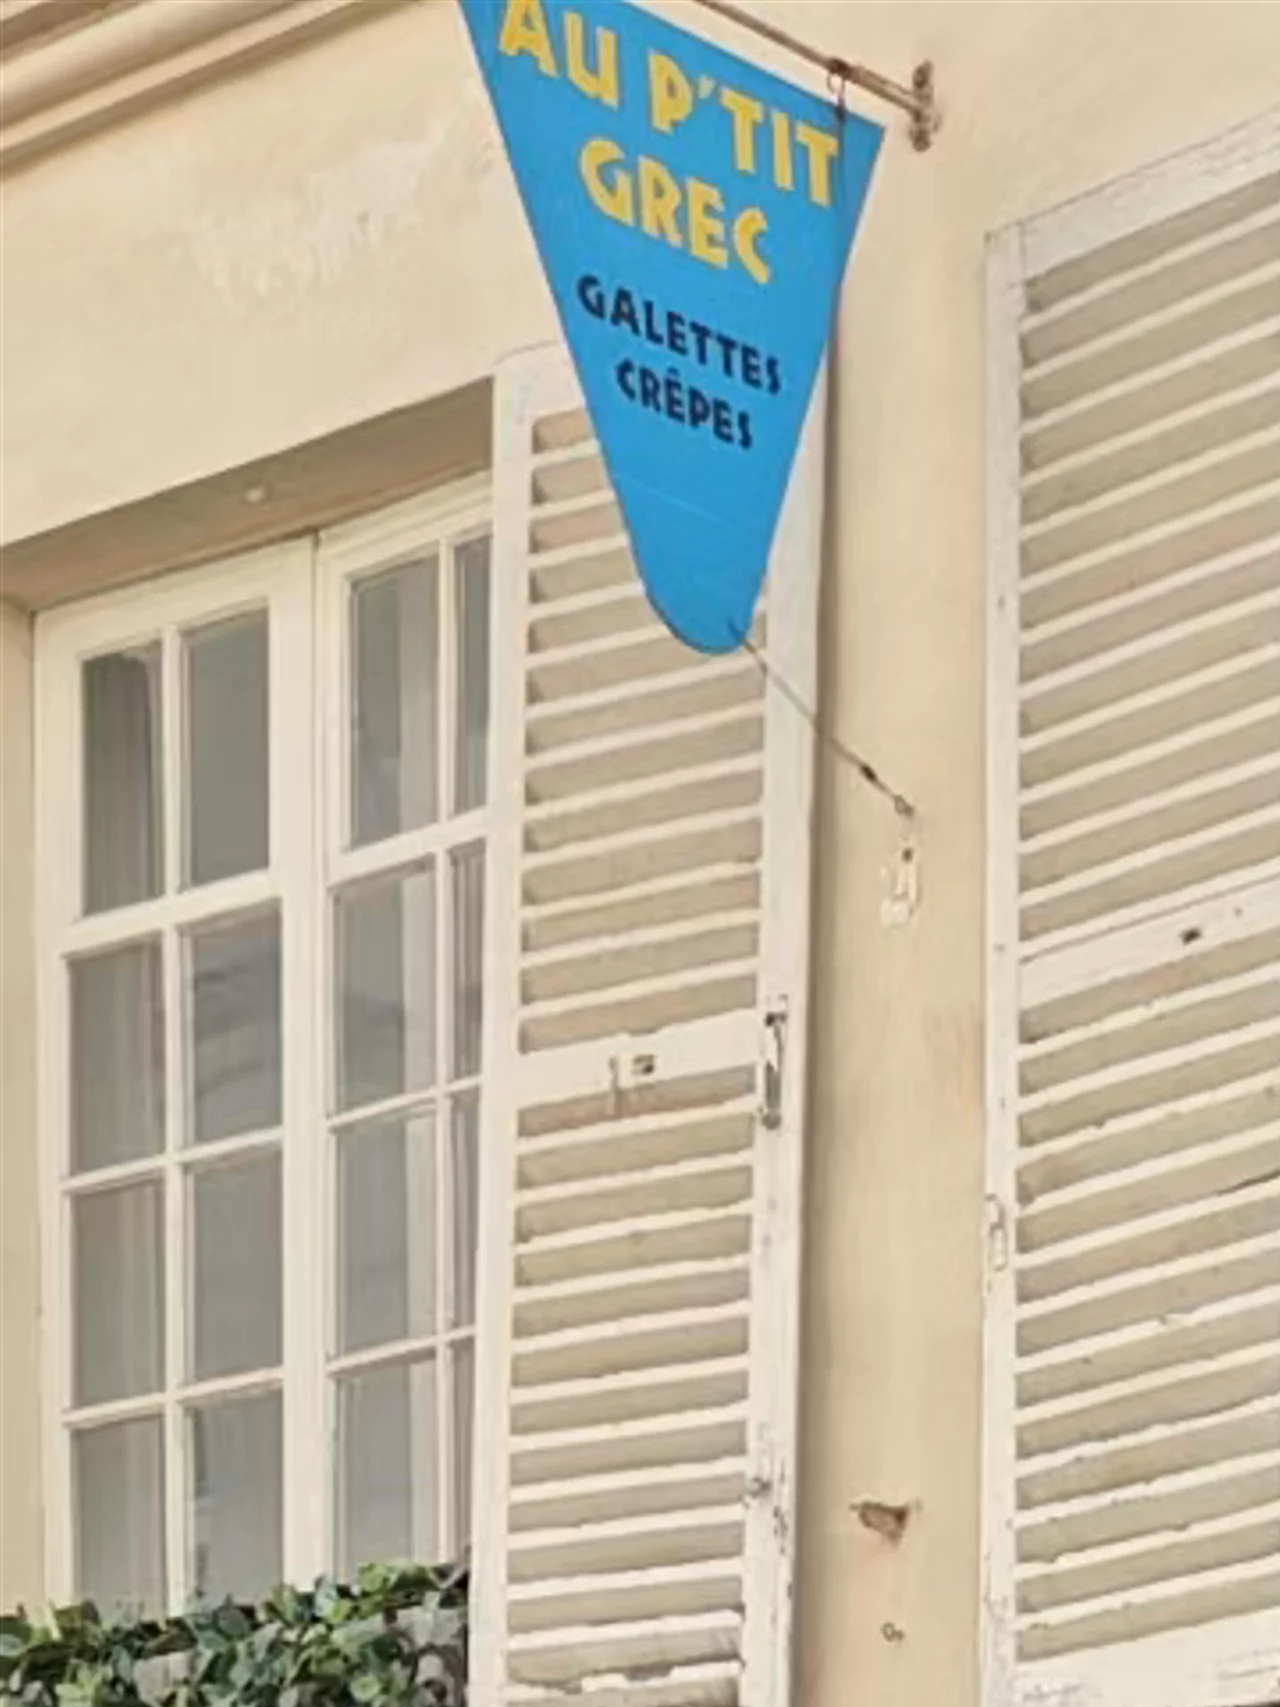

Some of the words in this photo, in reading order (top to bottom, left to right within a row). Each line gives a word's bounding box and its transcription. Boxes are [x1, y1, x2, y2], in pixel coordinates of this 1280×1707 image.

[499, 0, 619, 106] AU
[648, 52, 839, 206] P'TIT
[577, 137, 771, 285] GREC
[576, 273, 781, 396] GALETTES
[616, 358, 753, 451] CRÊPES
